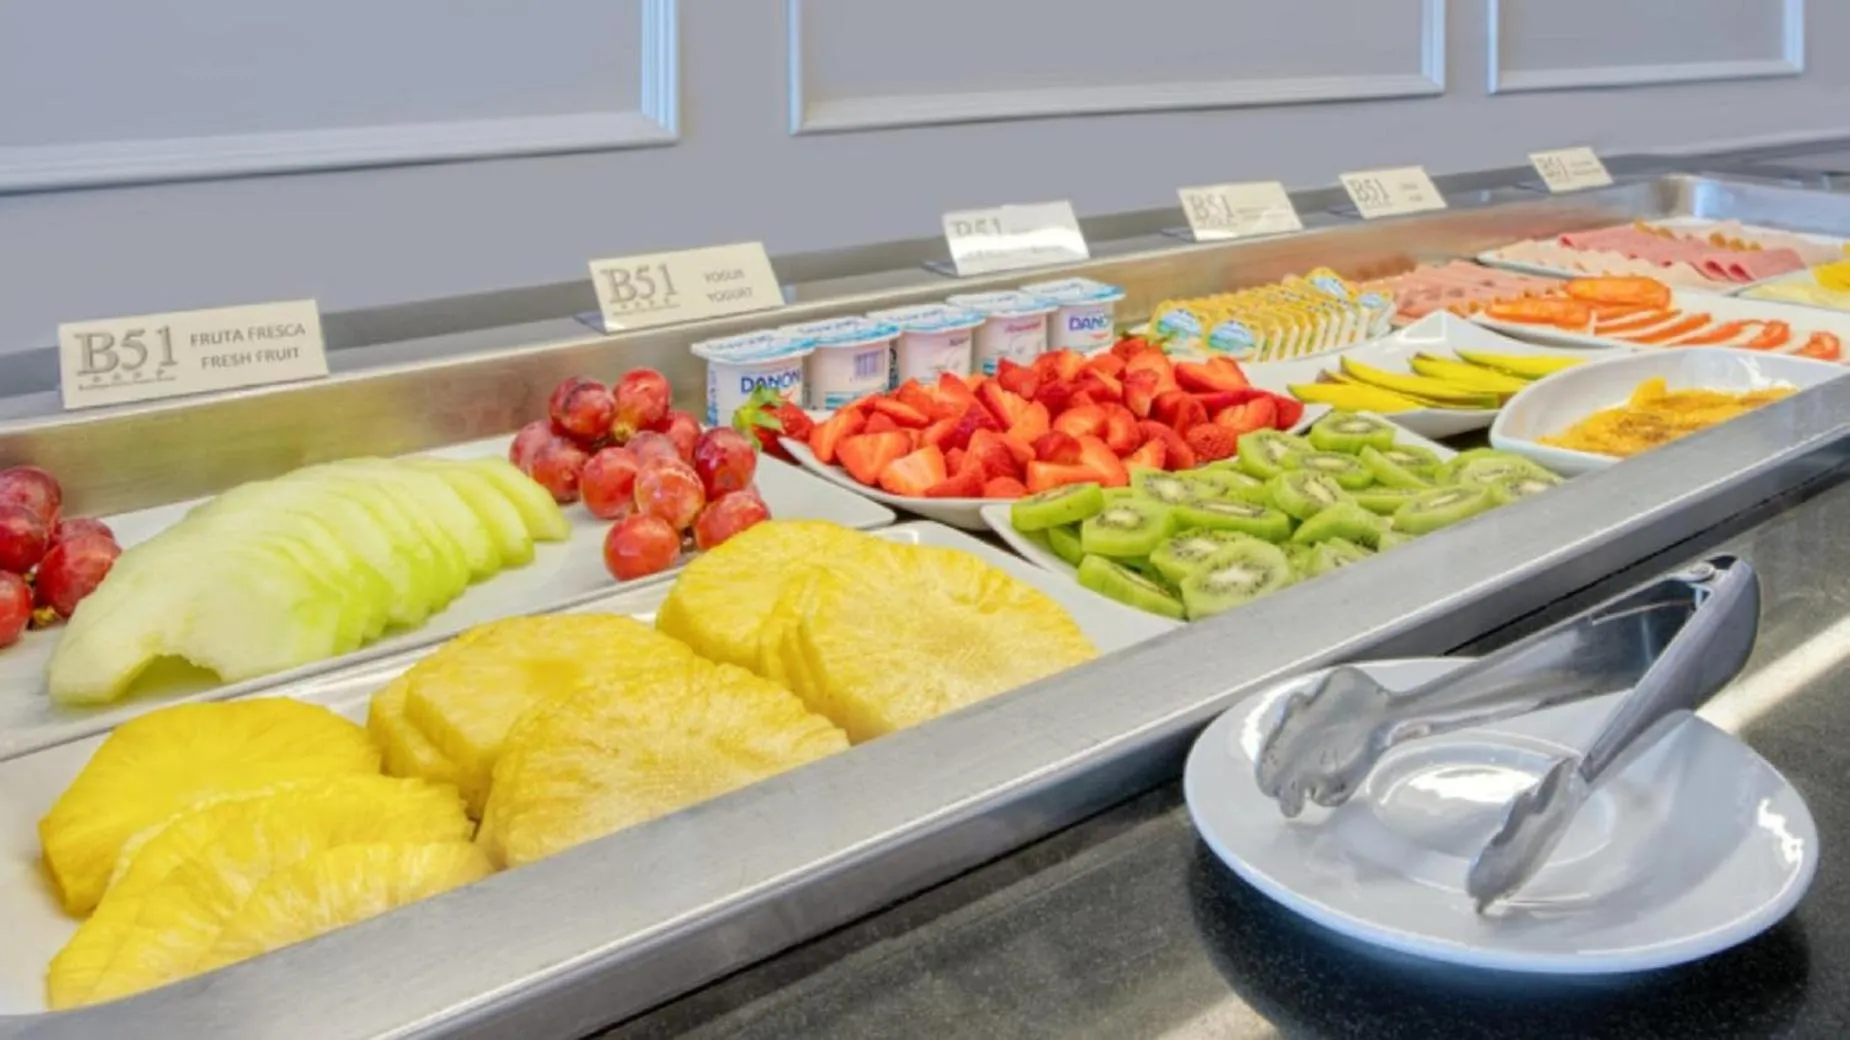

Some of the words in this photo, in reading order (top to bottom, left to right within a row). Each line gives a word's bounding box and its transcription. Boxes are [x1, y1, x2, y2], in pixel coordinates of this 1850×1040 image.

[600, 263, 679, 304] B51
[706, 286, 753, 303] YOGURT
[190, 328, 244, 347] FRUTA
[247, 323, 306, 341] FRESCA
[74, 324, 178, 376] B51
[201, 353, 251, 370] FRESH
[255, 347, 300, 364] FRUIT
